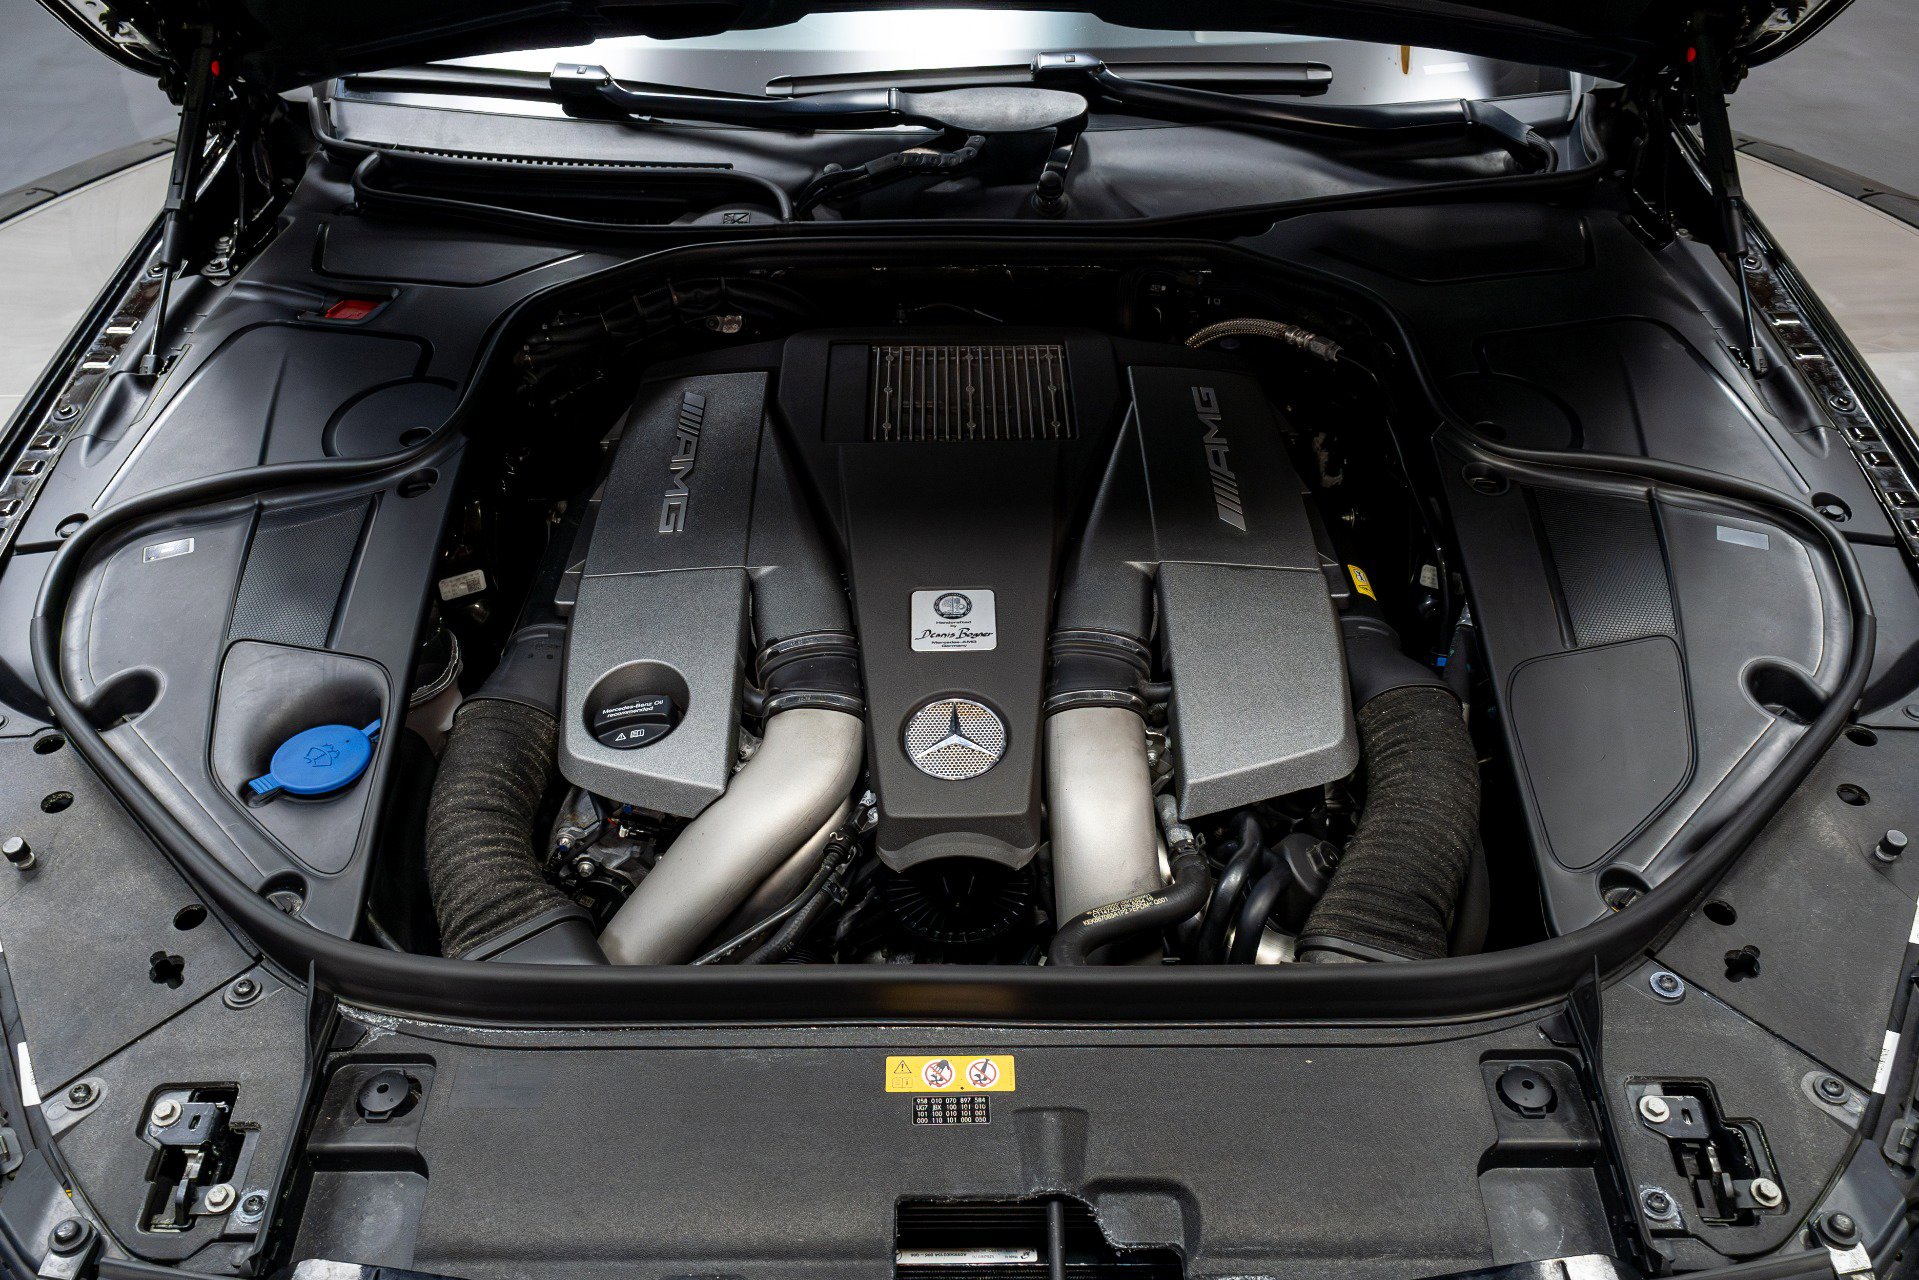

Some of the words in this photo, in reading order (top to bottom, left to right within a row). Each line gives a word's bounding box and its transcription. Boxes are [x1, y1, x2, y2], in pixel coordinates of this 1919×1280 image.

[1191, 387, 1238, 490] AMG
[658, 418, 700, 533] AMG
[914, 629, 955, 640] Dennis
[955, 627, 993, 640] Bogner
[602, 702, 653, 715] Mercedes-Benz
[606, 706, 654, 718] recommended
